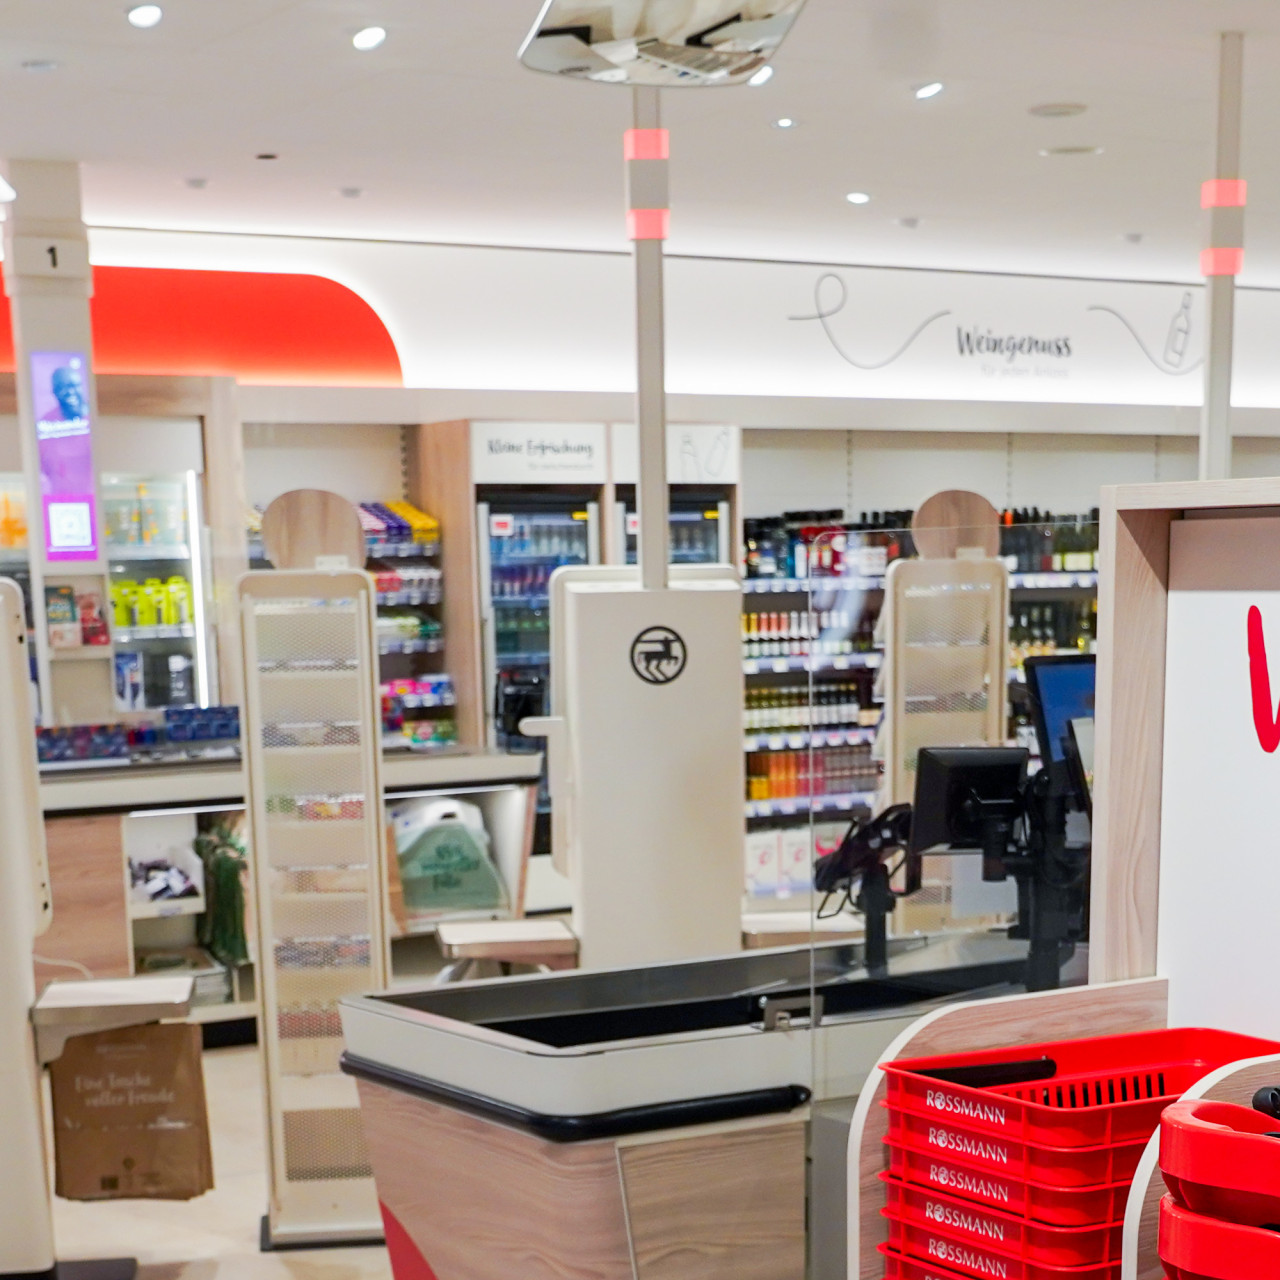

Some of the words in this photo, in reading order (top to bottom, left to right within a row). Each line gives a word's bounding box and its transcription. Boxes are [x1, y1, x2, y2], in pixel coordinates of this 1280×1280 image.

[47, 246, 58, 269] 1
[956, 324, 1072, 363] Weingenuss
[926, 1089, 1005, 1126] ROSSMANN
[928, 1126, 1008, 1164] ROSSMANN
[929, 1163, 1009, 1203] ROSSMANN
[925, 1200, 1004, 1242] ROSSMANN
[928, 1237, 1007, 1279] ROSSMANN
